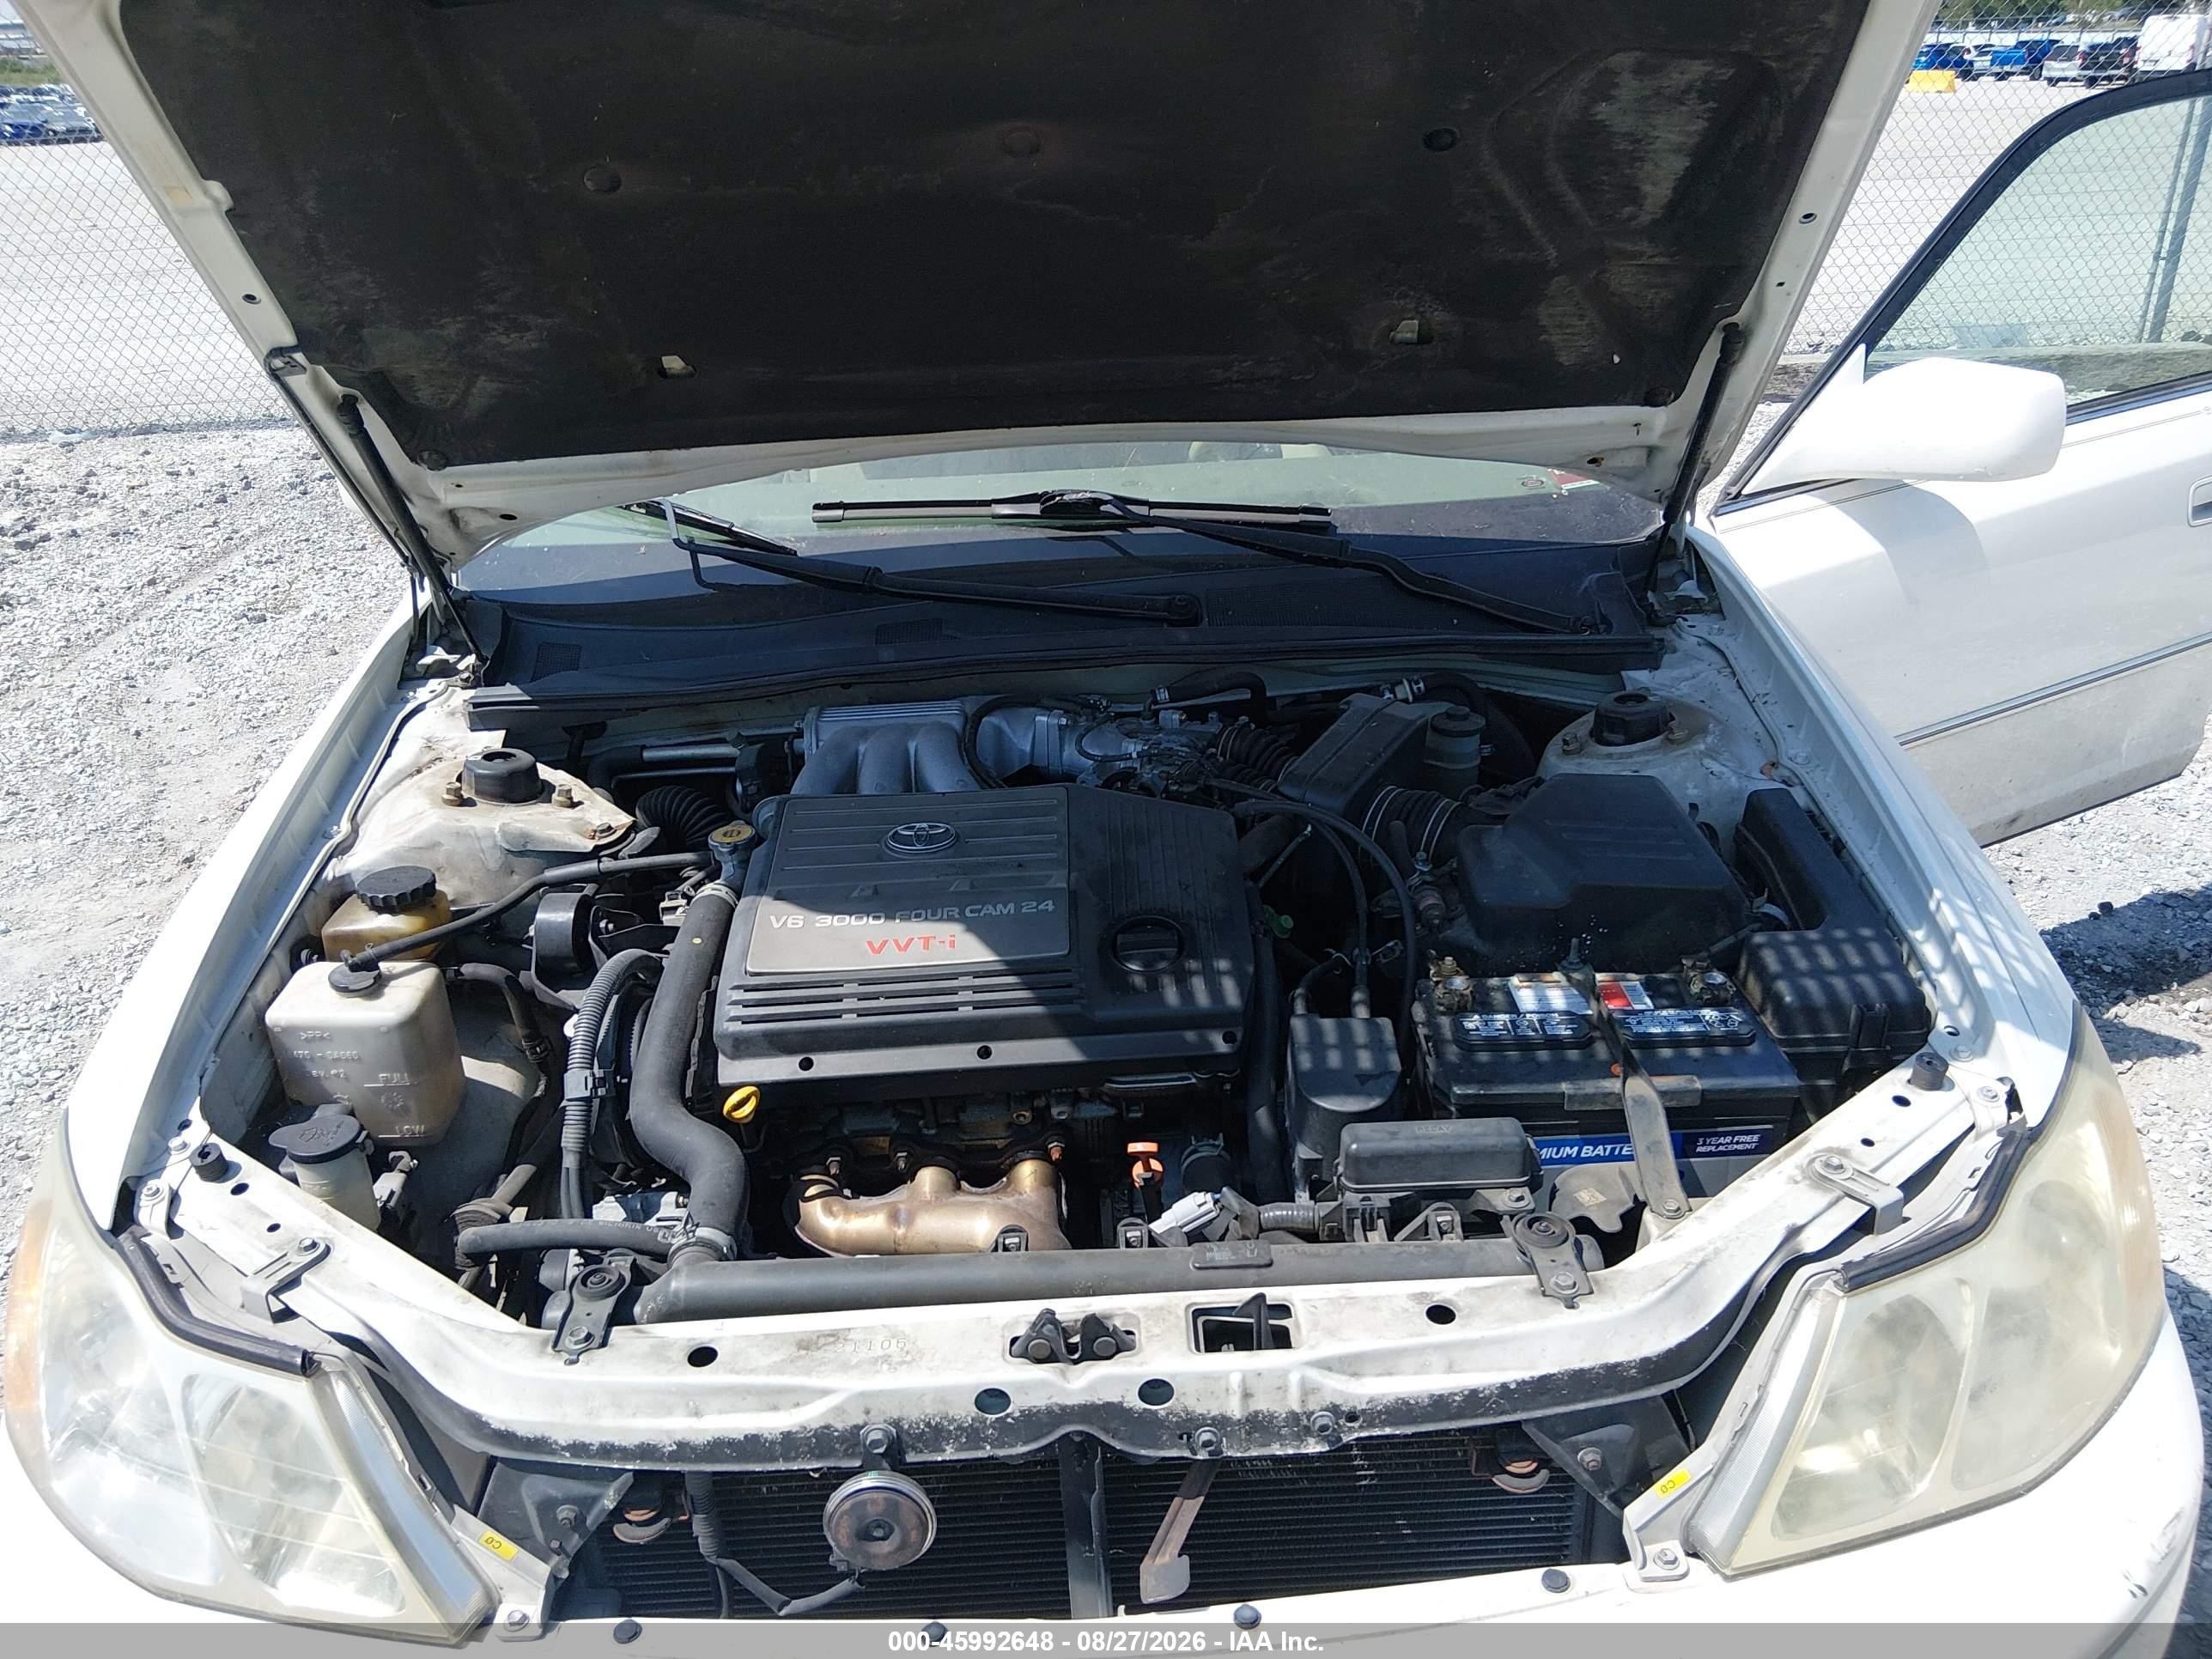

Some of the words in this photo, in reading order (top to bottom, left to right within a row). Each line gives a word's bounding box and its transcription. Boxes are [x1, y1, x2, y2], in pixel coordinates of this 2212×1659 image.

[769, 915, 805, 928] V6
[815, 912, 885, 927] 3000
[895, 907, 961, 923] FOUR
[965, 902, 1015, 919] CAM
[1021, 900, 1055, 913] 24
[866, 933, 957, 956] VVT-i
[378, 1073, 410, 1084] FULL
[1696, 1137, 1705, 1146] 3
[1705, 1135, 1733, 1146] YEAR
[1733, 1133, 1761, 1144] FREE
[1696, 1143, 1759, 1153] REPLACEMENT
